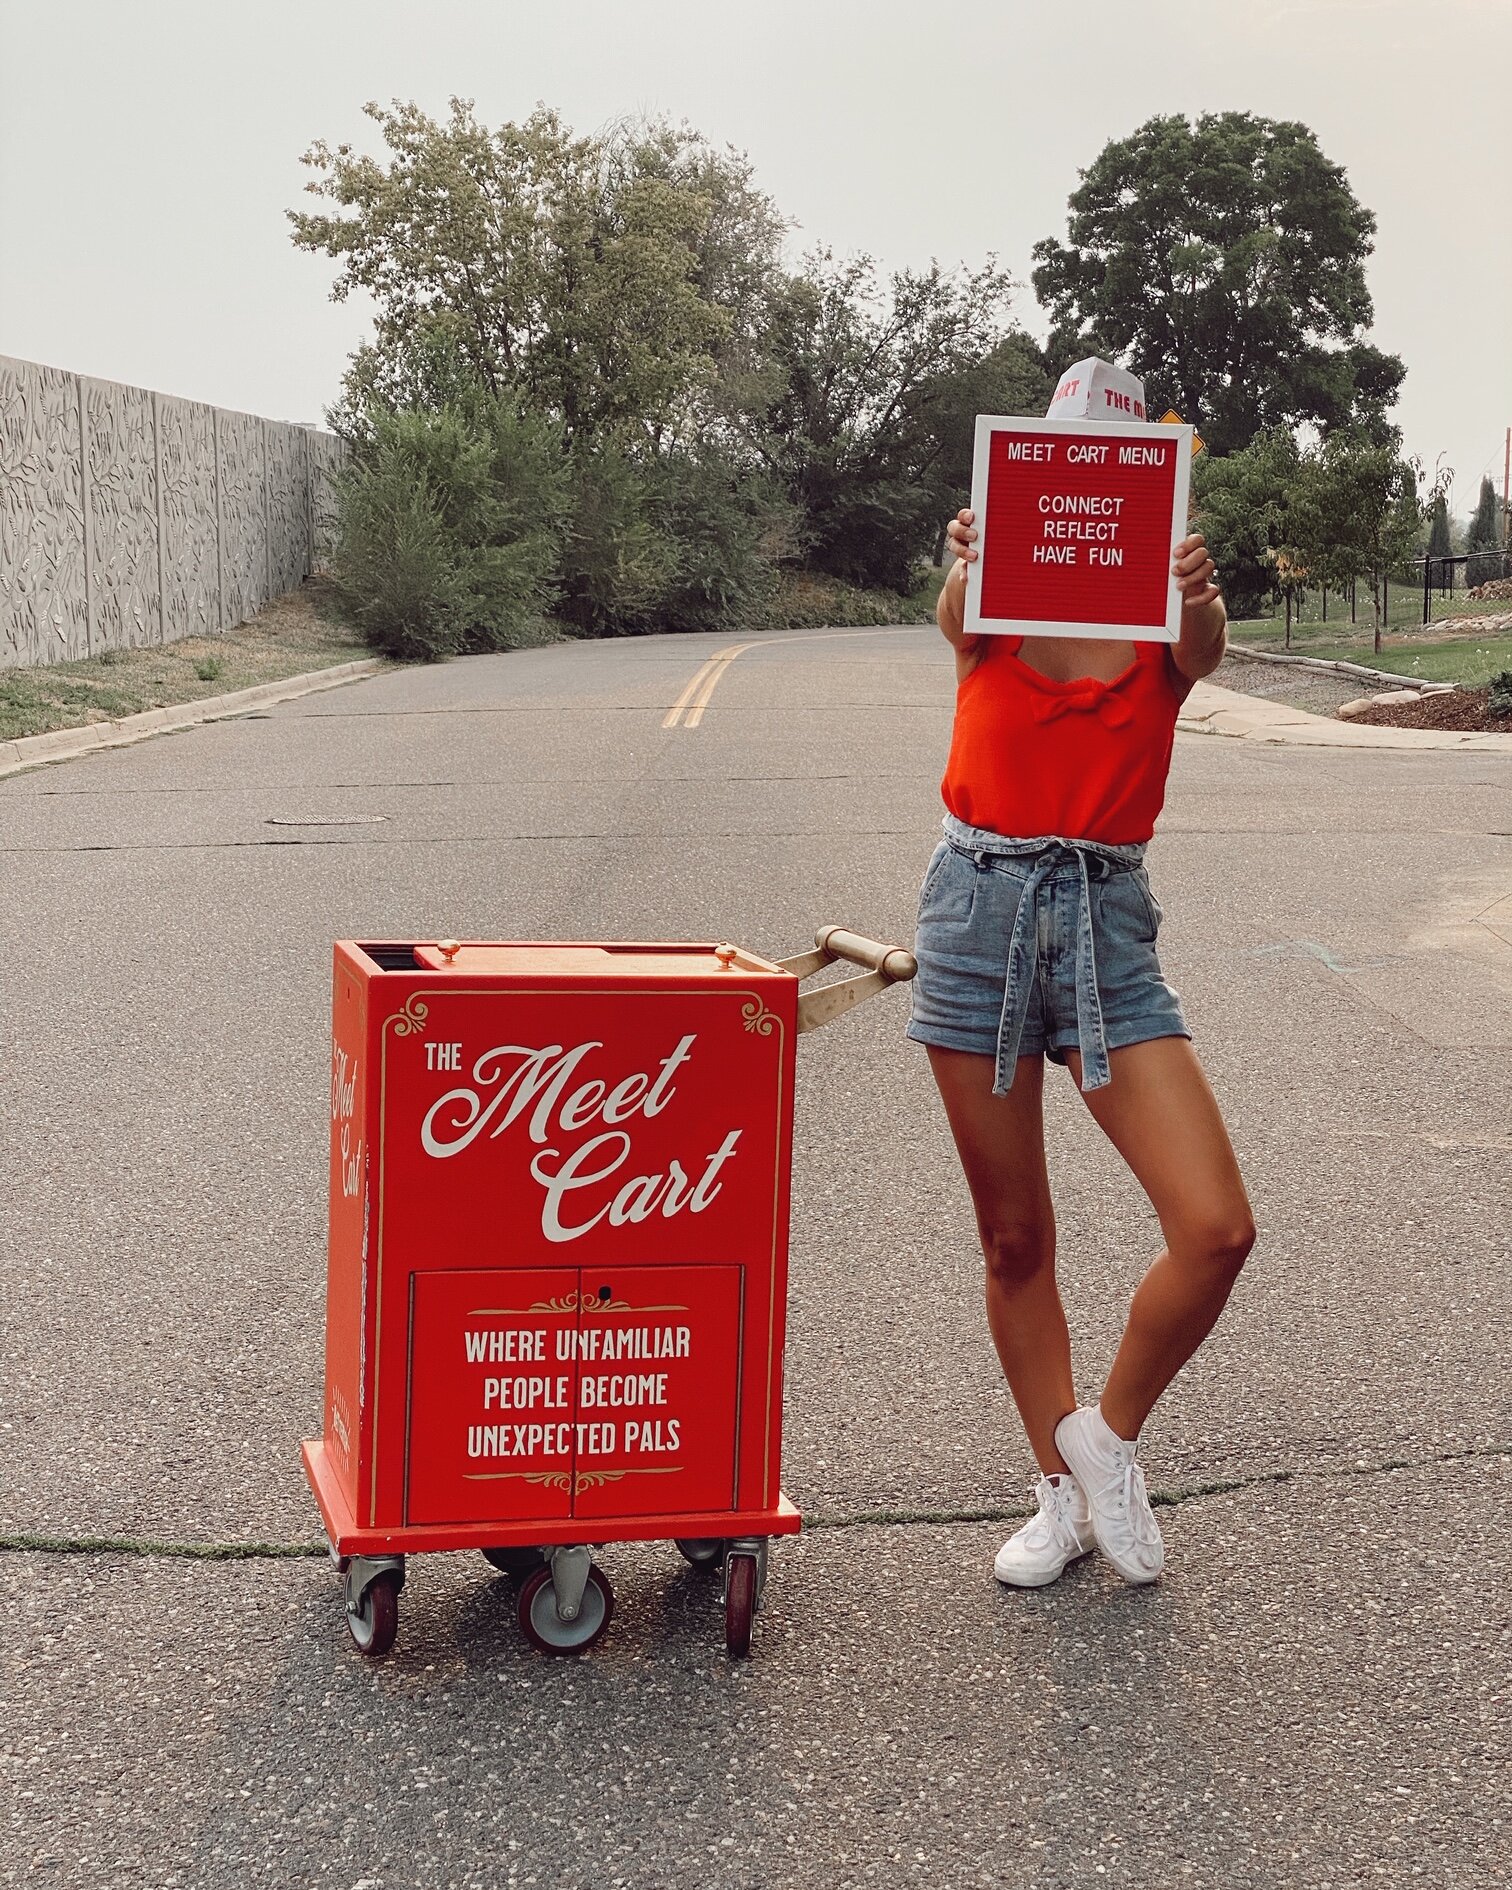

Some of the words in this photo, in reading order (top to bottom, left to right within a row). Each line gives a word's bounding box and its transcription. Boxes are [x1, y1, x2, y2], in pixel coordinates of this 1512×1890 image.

[1104, 388, 1131, 413] THE
[1007, 442, 1055, 462] MEET
[1066, 445, 1109, 464] CART
[1118, 447, 1166, 466] MENU
[1038, 495, 1124, 516] CONNECT
[1043, 520, 1119, 541] REFLECT
[1033, 545, 1077, 564] HAVE
[1089, 547, 1123, 566] FUN
[424, 1042, 463, 1072] THE
[420, 1033, 697, 1159] Meet
[530, 1128, 743, 1243] Cart
[464, 1329, 547, 1363] WHERE
[555, 1326, 691, 1361] UNFAMILIAR
[483, 1376, 569, 1410] PEOPLE
[580, 1373, 668, 1408] BECOME
[467, 1422, 616, 1458] UNEXPECTED
[624, 1419, 681, 1454] PALS
